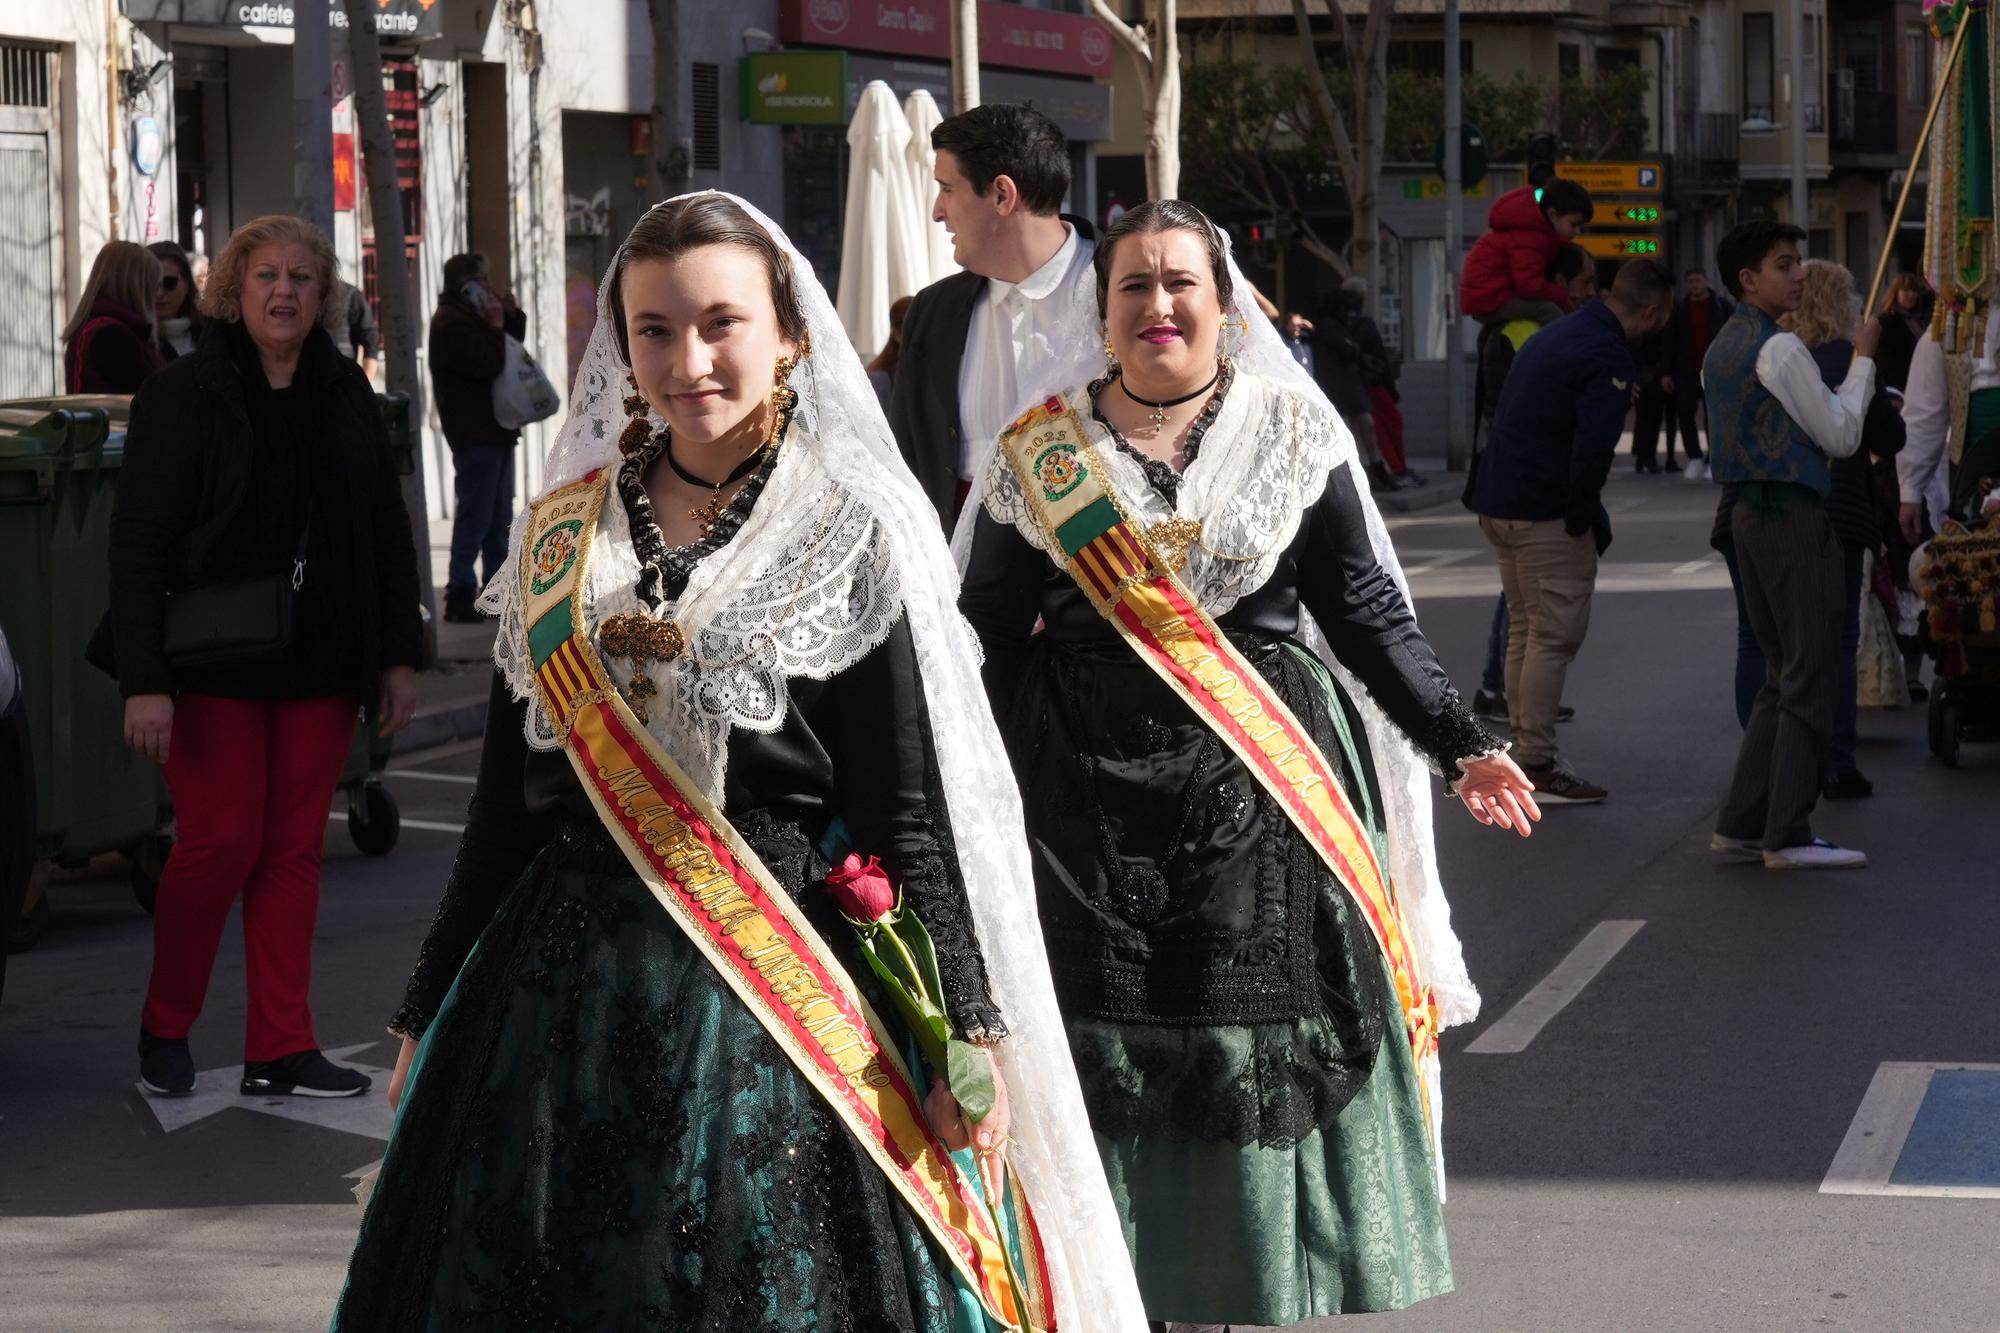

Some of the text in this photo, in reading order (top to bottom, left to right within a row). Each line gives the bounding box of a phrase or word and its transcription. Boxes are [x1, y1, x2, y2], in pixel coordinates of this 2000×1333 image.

[1141, 615, 1324, 798] MADRINA
[598, 765, 890, 1088] MADRINA INFANTIL
